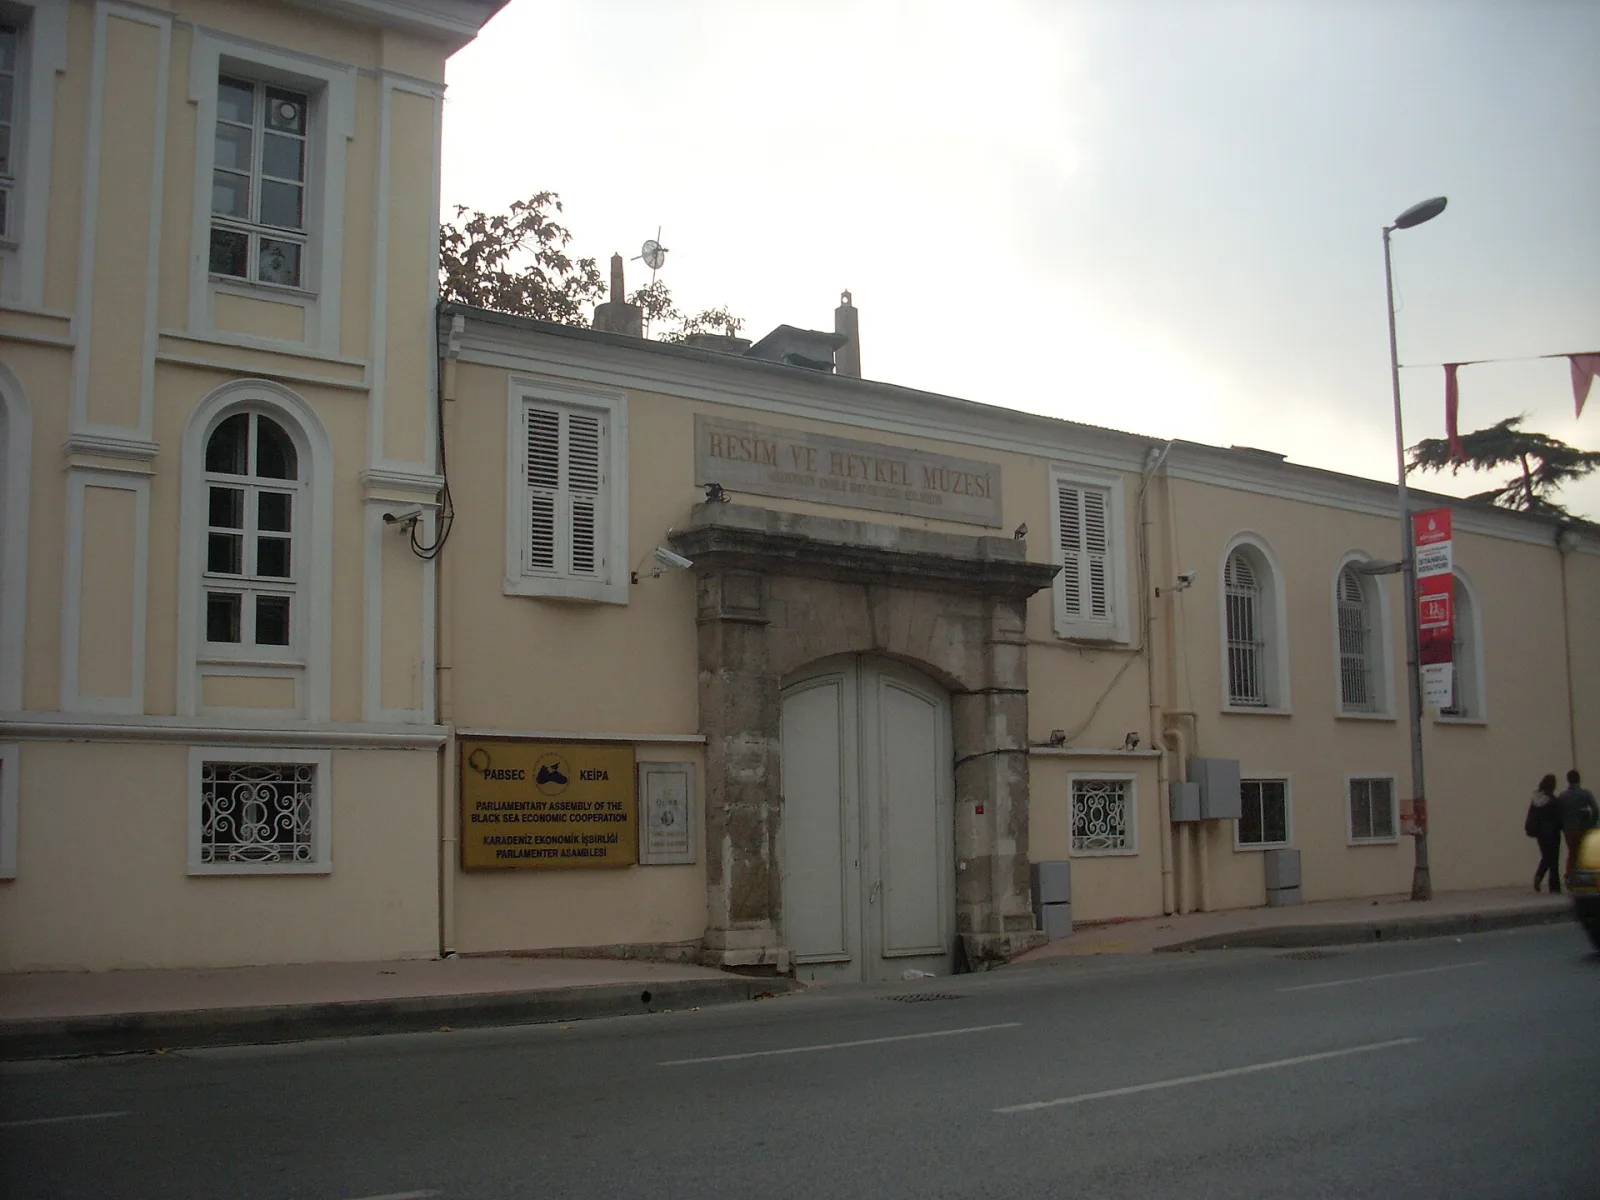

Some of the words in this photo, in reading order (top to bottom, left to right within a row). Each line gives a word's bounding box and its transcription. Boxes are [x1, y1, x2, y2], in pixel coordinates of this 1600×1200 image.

[708, 428, 777, 467] RESİM
[790, 444, 818, 472] VE
[829, 451, 912, 487] HEYKEL
[922, 464, 993, 499] MÜZESİ
[484, 769, 525, 781] PABSEC
[580, 767, 609, 781] KEİPA
[476, 801, 547, 811] PARLIAMENTARY
[549, 801, 592, 811] ASSEMBLY
[594, 801, 605, 811] OF
[607, 801, 623, 811] THE
[471, 813, 501, 823] BLACK
[503, 813, 519, 823] SEA
[521, 813, 567, 823] ECONOMIC
[569, 813, 627, 823] COOPERATION
[483, 833, 532, 845] KARADENİZ
[534, 832, 580, 845] EKONOMİK
[496, 849, 558, 859] PARLAMENTER
[560, 848, 607, 858] ASAMBLESİ
